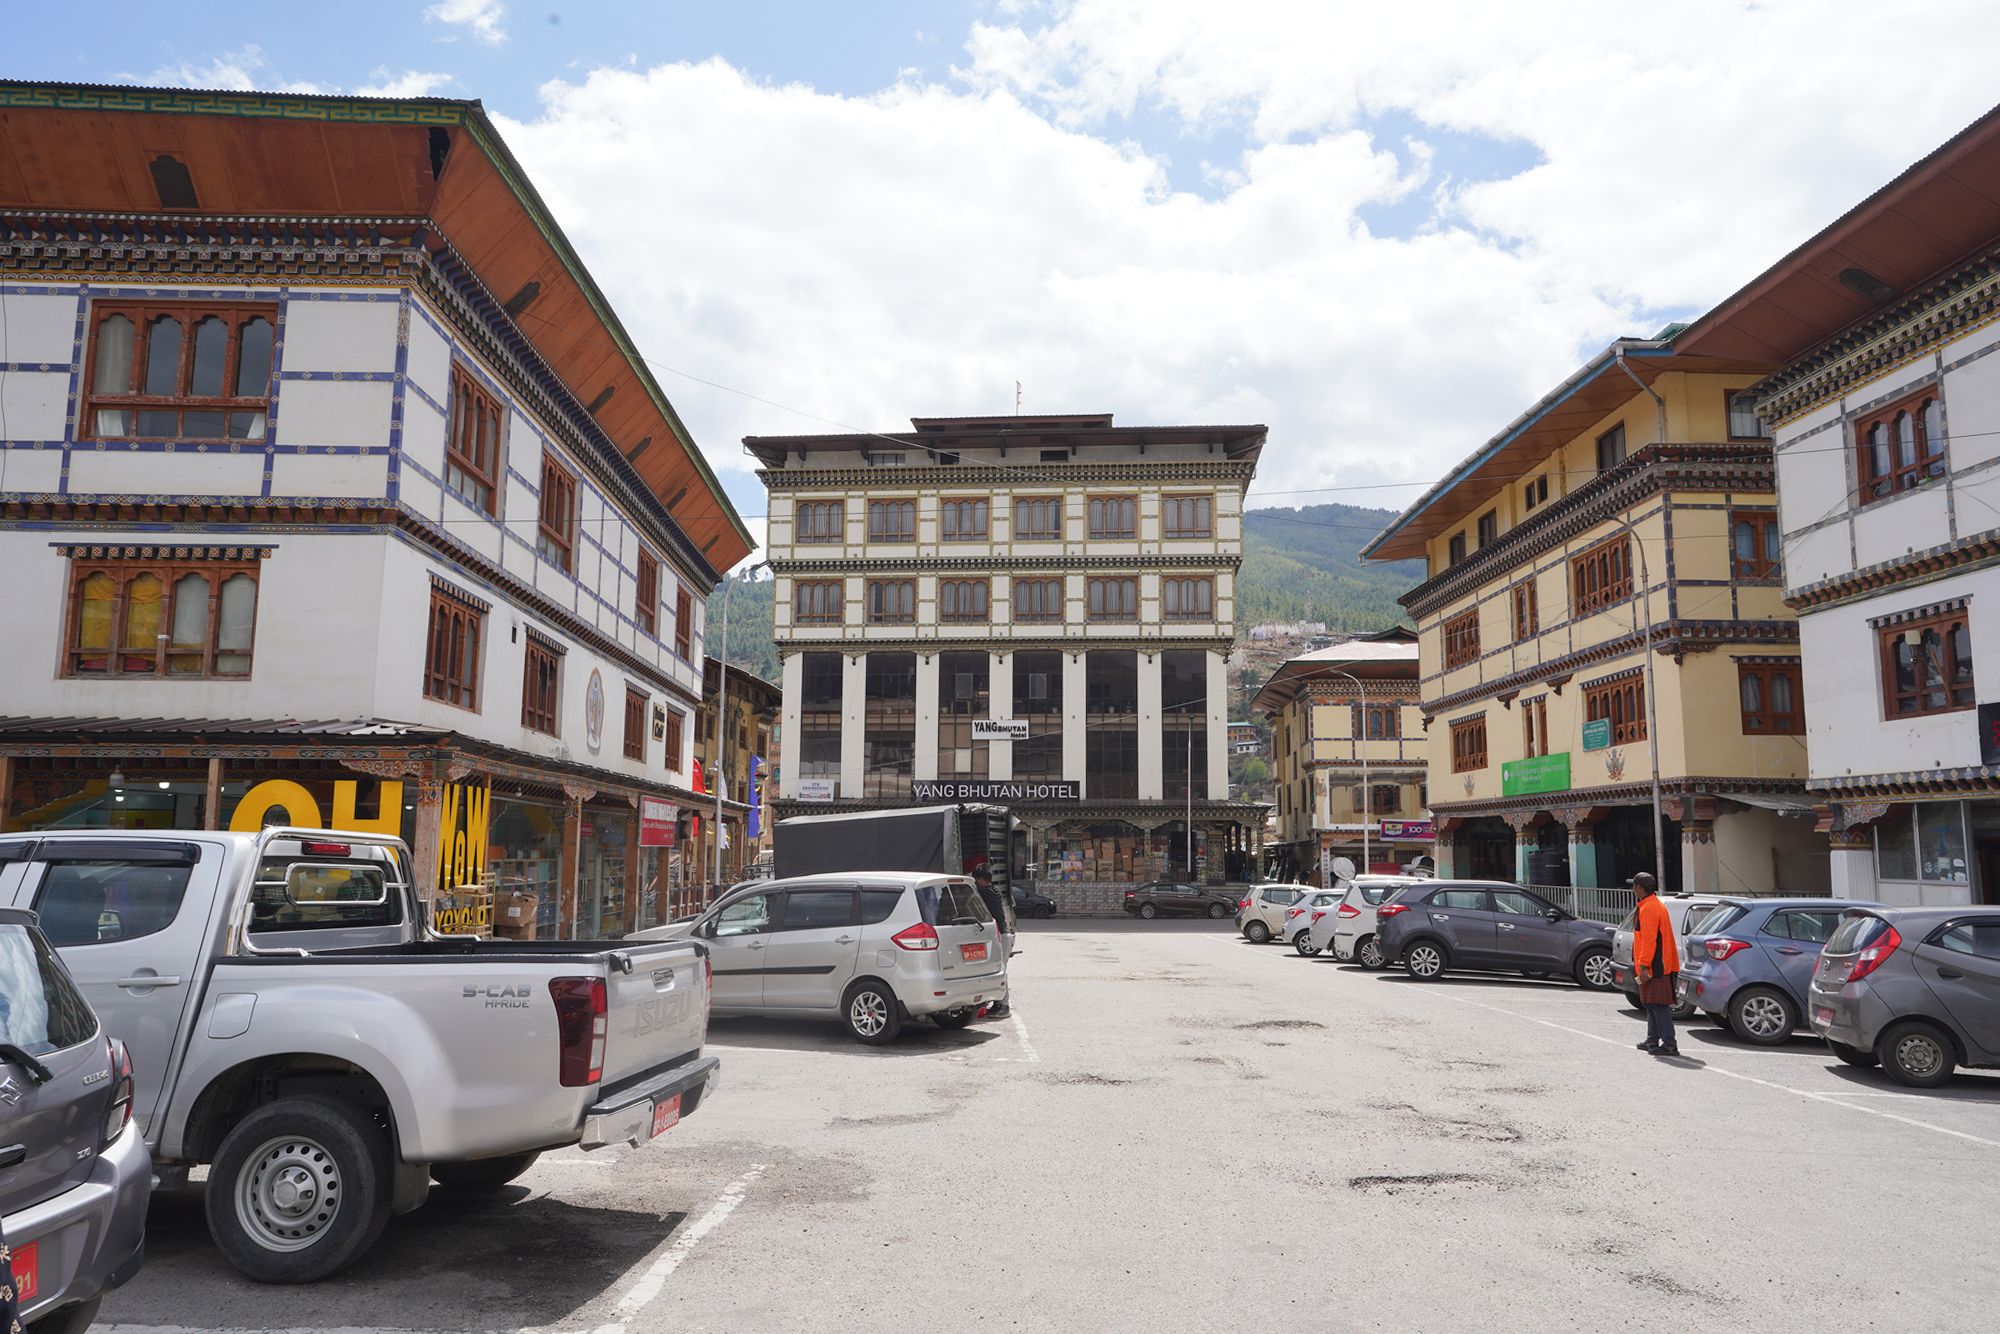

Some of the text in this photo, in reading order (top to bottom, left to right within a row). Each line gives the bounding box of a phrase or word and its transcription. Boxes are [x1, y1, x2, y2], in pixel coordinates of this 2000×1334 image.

[974, 721, 1027, 733] YANG BHUTAN
[913, 785, 1078, 799] YANG BHUTAN HOTEL
[463, 984, 531, 998] S-CAB
[633, 990, 692, 1038] ISUZU
